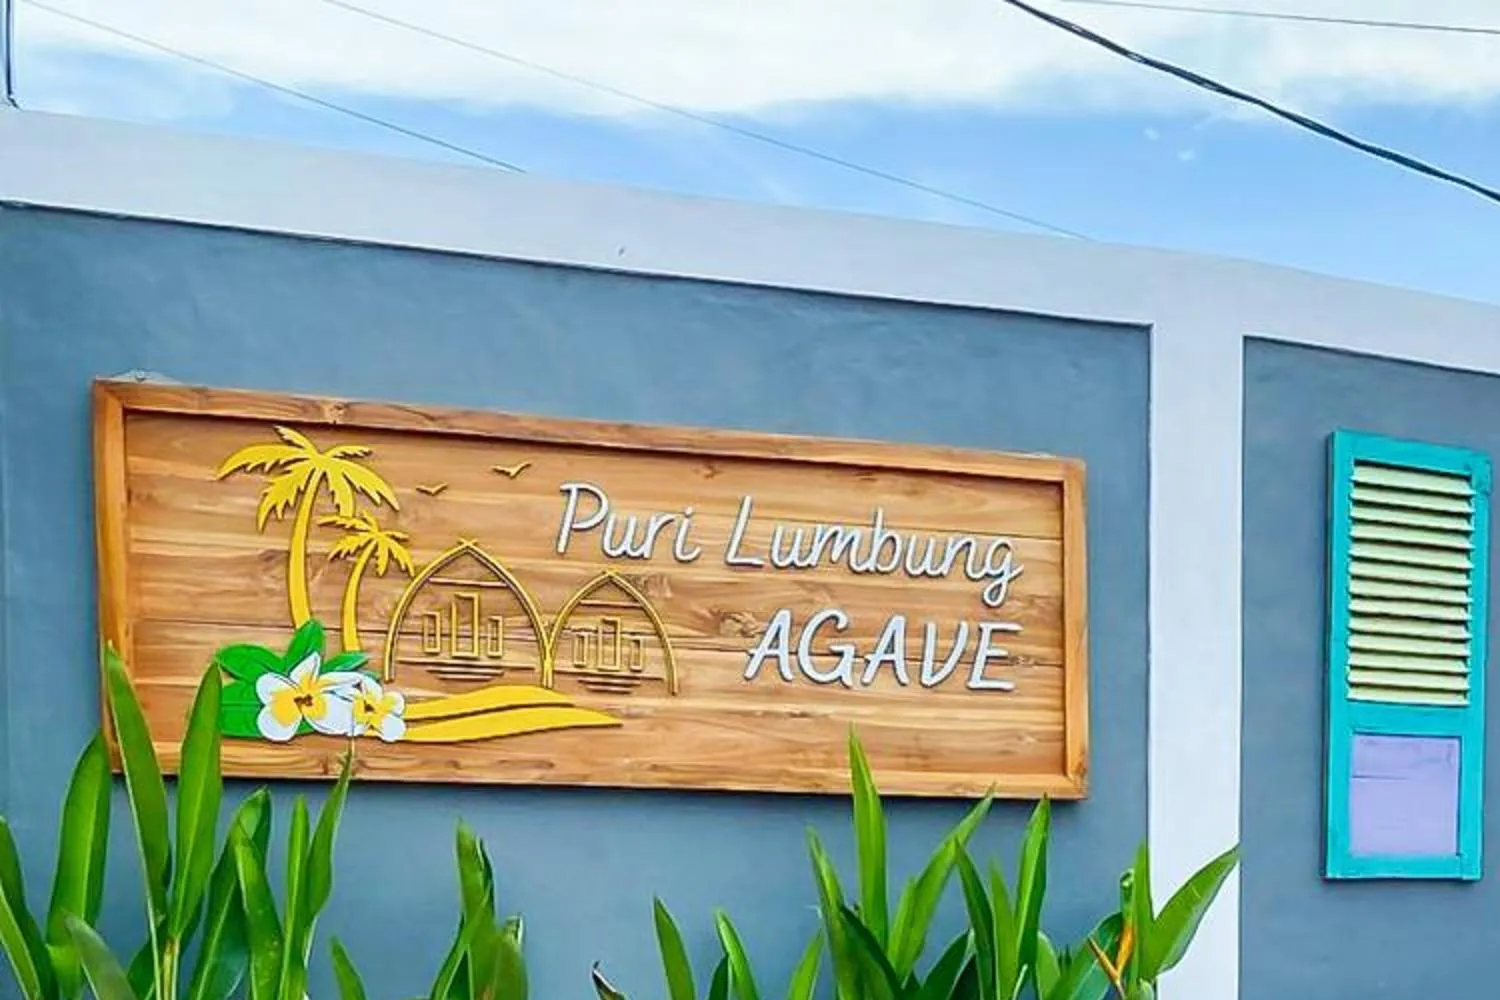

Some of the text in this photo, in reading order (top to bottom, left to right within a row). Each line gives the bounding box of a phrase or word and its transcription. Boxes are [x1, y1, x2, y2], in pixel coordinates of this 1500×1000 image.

[556, 481, 1024, 606] Puri Lumbung
[743, 607, 1023, 691] AGAVE
